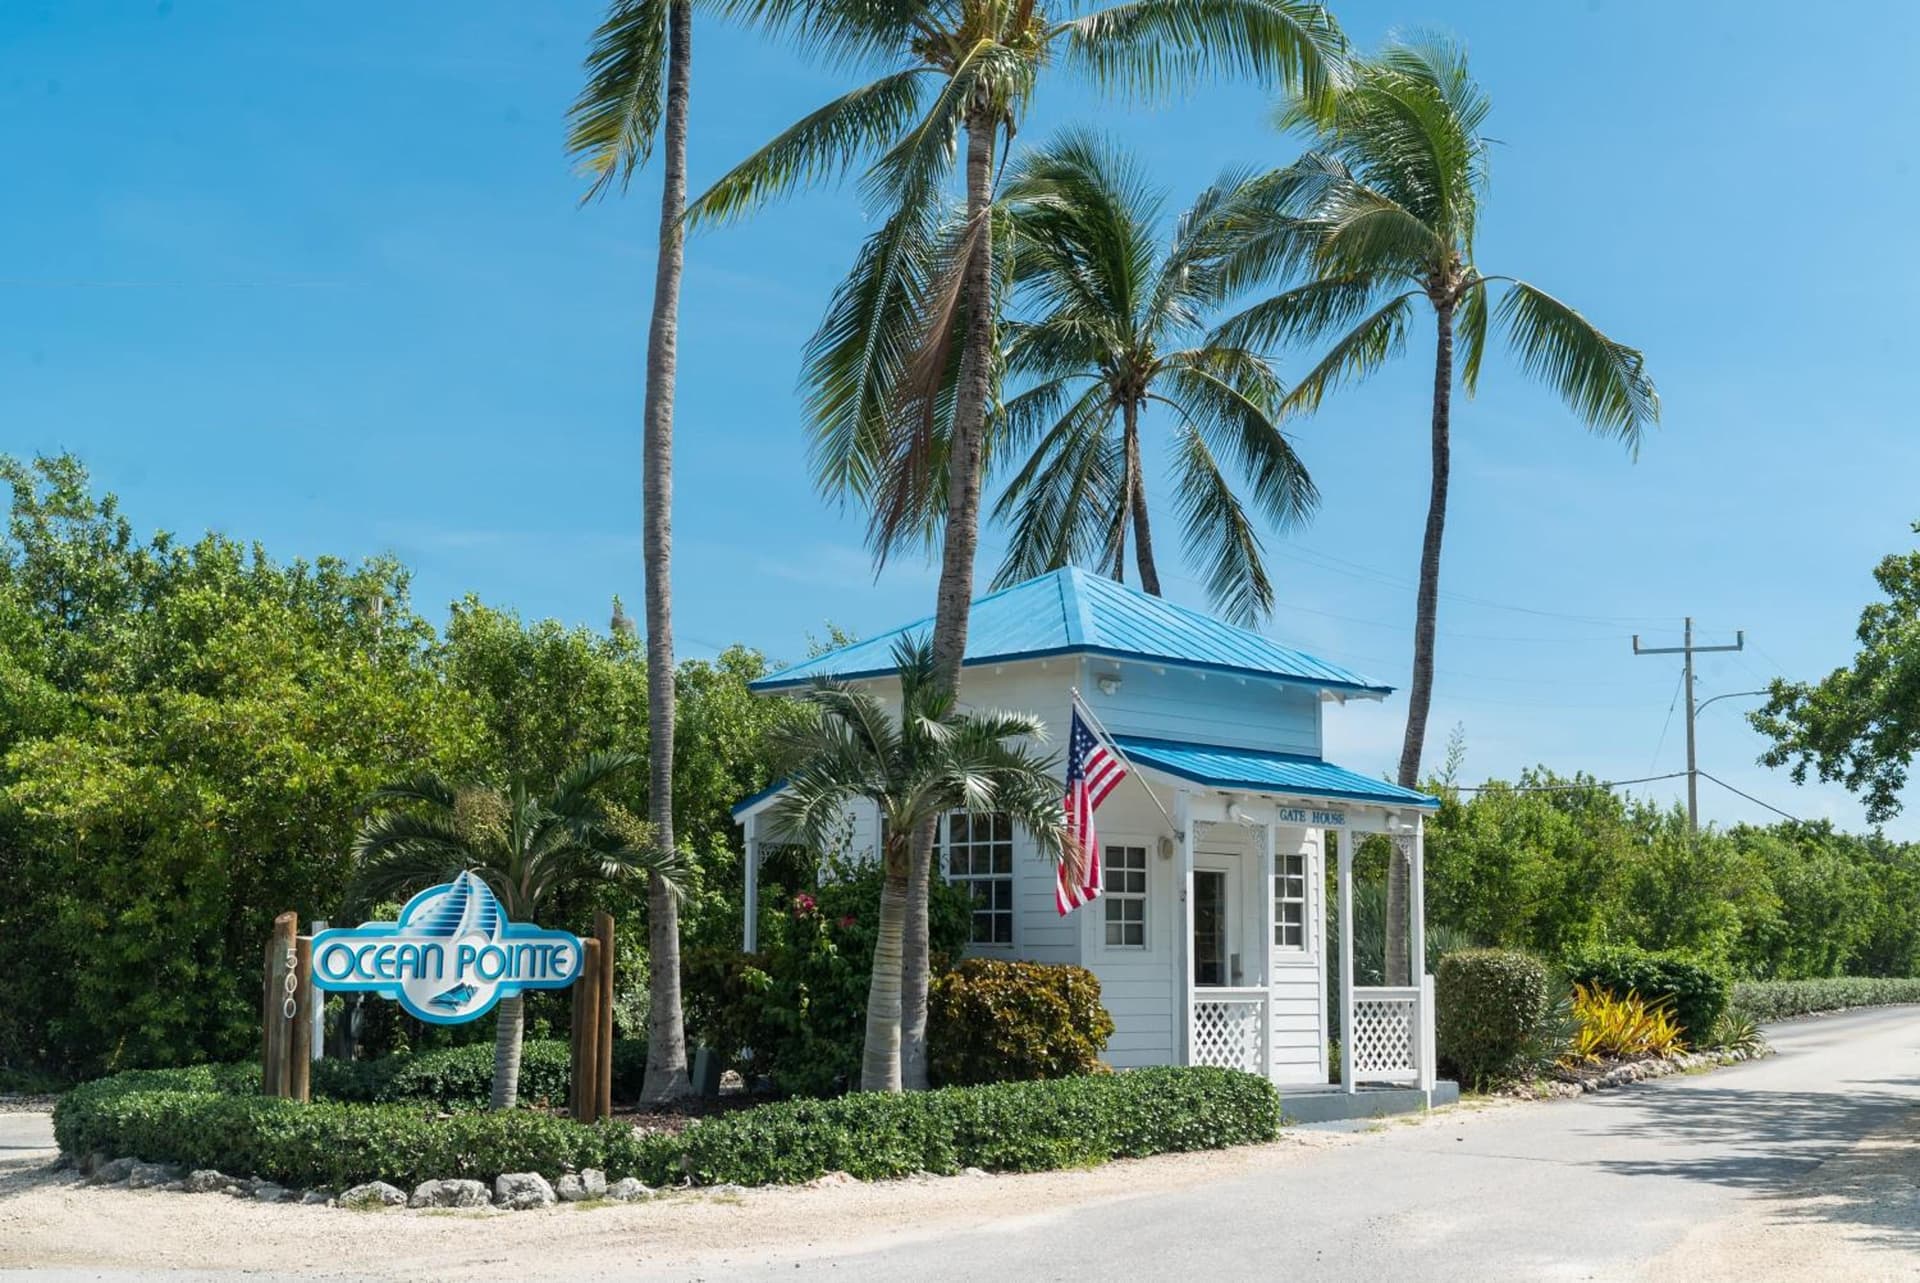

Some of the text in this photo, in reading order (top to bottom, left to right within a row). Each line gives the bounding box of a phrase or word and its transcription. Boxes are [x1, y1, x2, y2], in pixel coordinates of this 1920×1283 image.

[1280, 808, 1345, 825] GATE HOUSE
[320, 943, 568, 981] OCEAN POINTE
[283, 948, 298, 1019] 500
